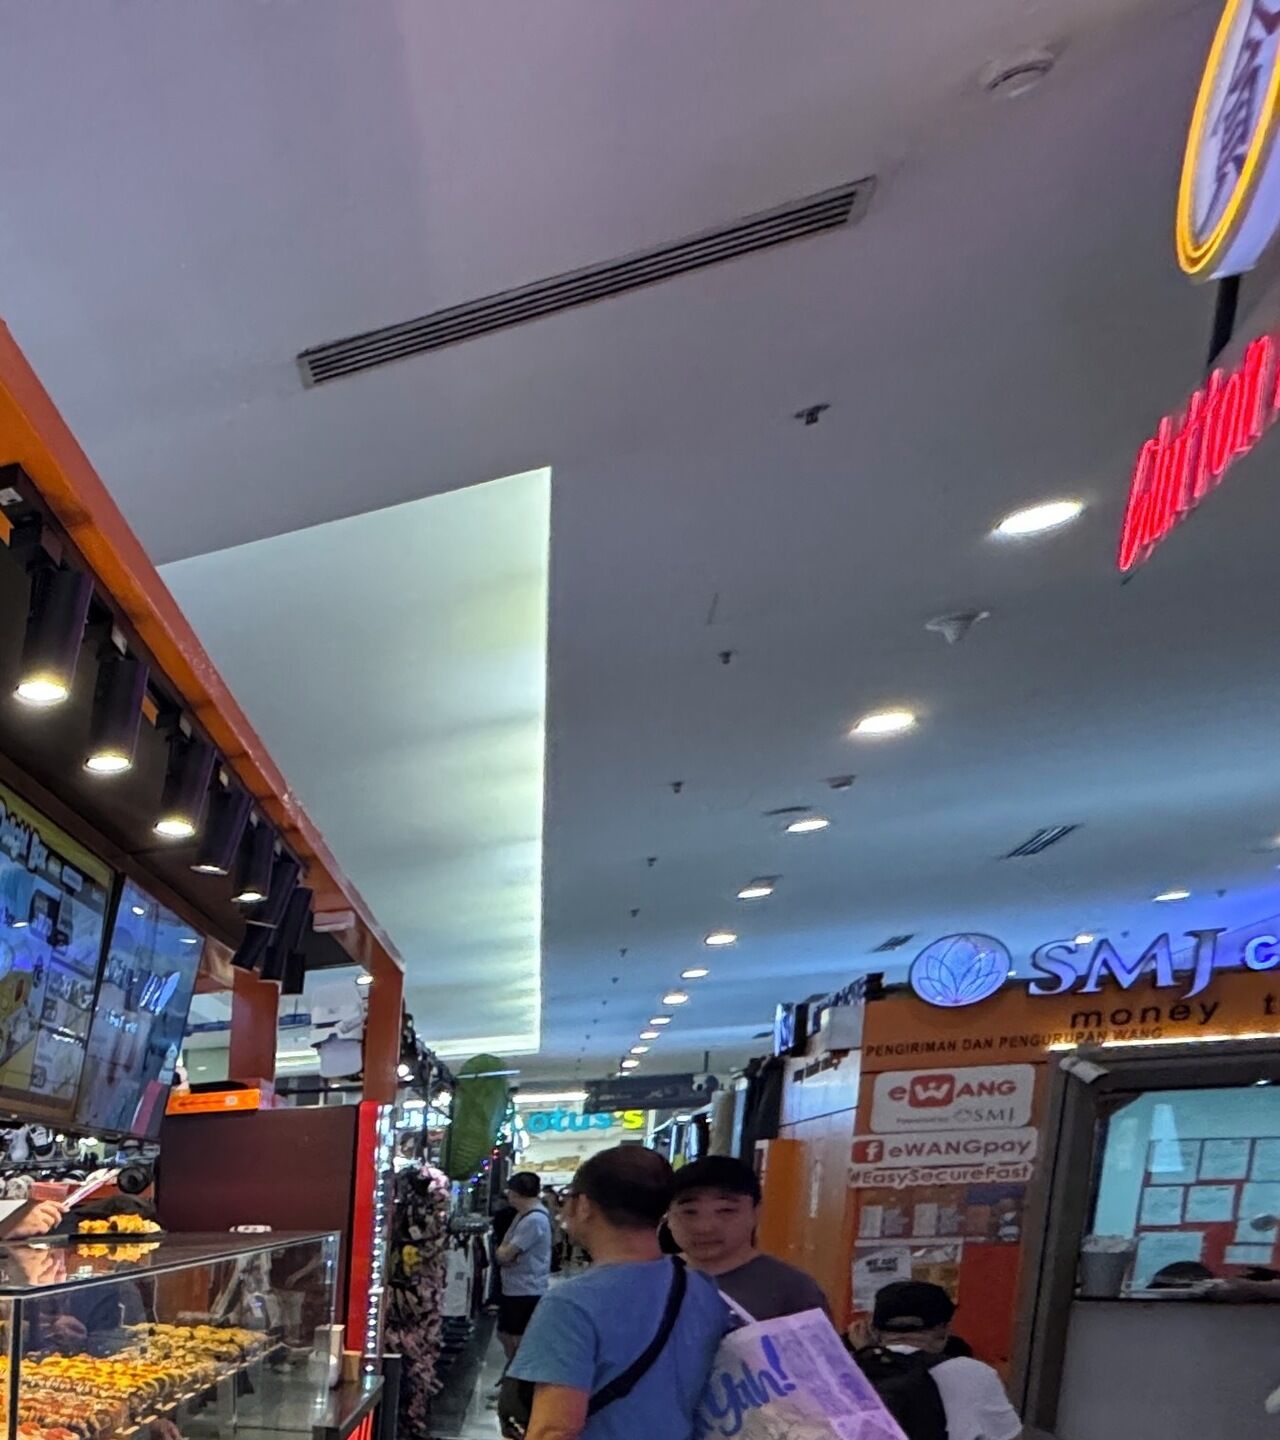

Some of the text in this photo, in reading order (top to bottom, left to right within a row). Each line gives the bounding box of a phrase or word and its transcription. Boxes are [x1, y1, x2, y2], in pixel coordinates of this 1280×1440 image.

[1028, 927, 1227, 1000] SMJ
[1070, 1001, 1219, 1028] money
[866, 1026, 1164, 1057] PENGIRIMAN DAN PENGURUPAN WANG
[888, 1073, 1018, 1108] eWANG
[526, 1106, 645, 1135] otus's
[889, 1139, 1031, 1159] eWANGpay
[850, 1164, 1030, 1185] #EasySecureFast
